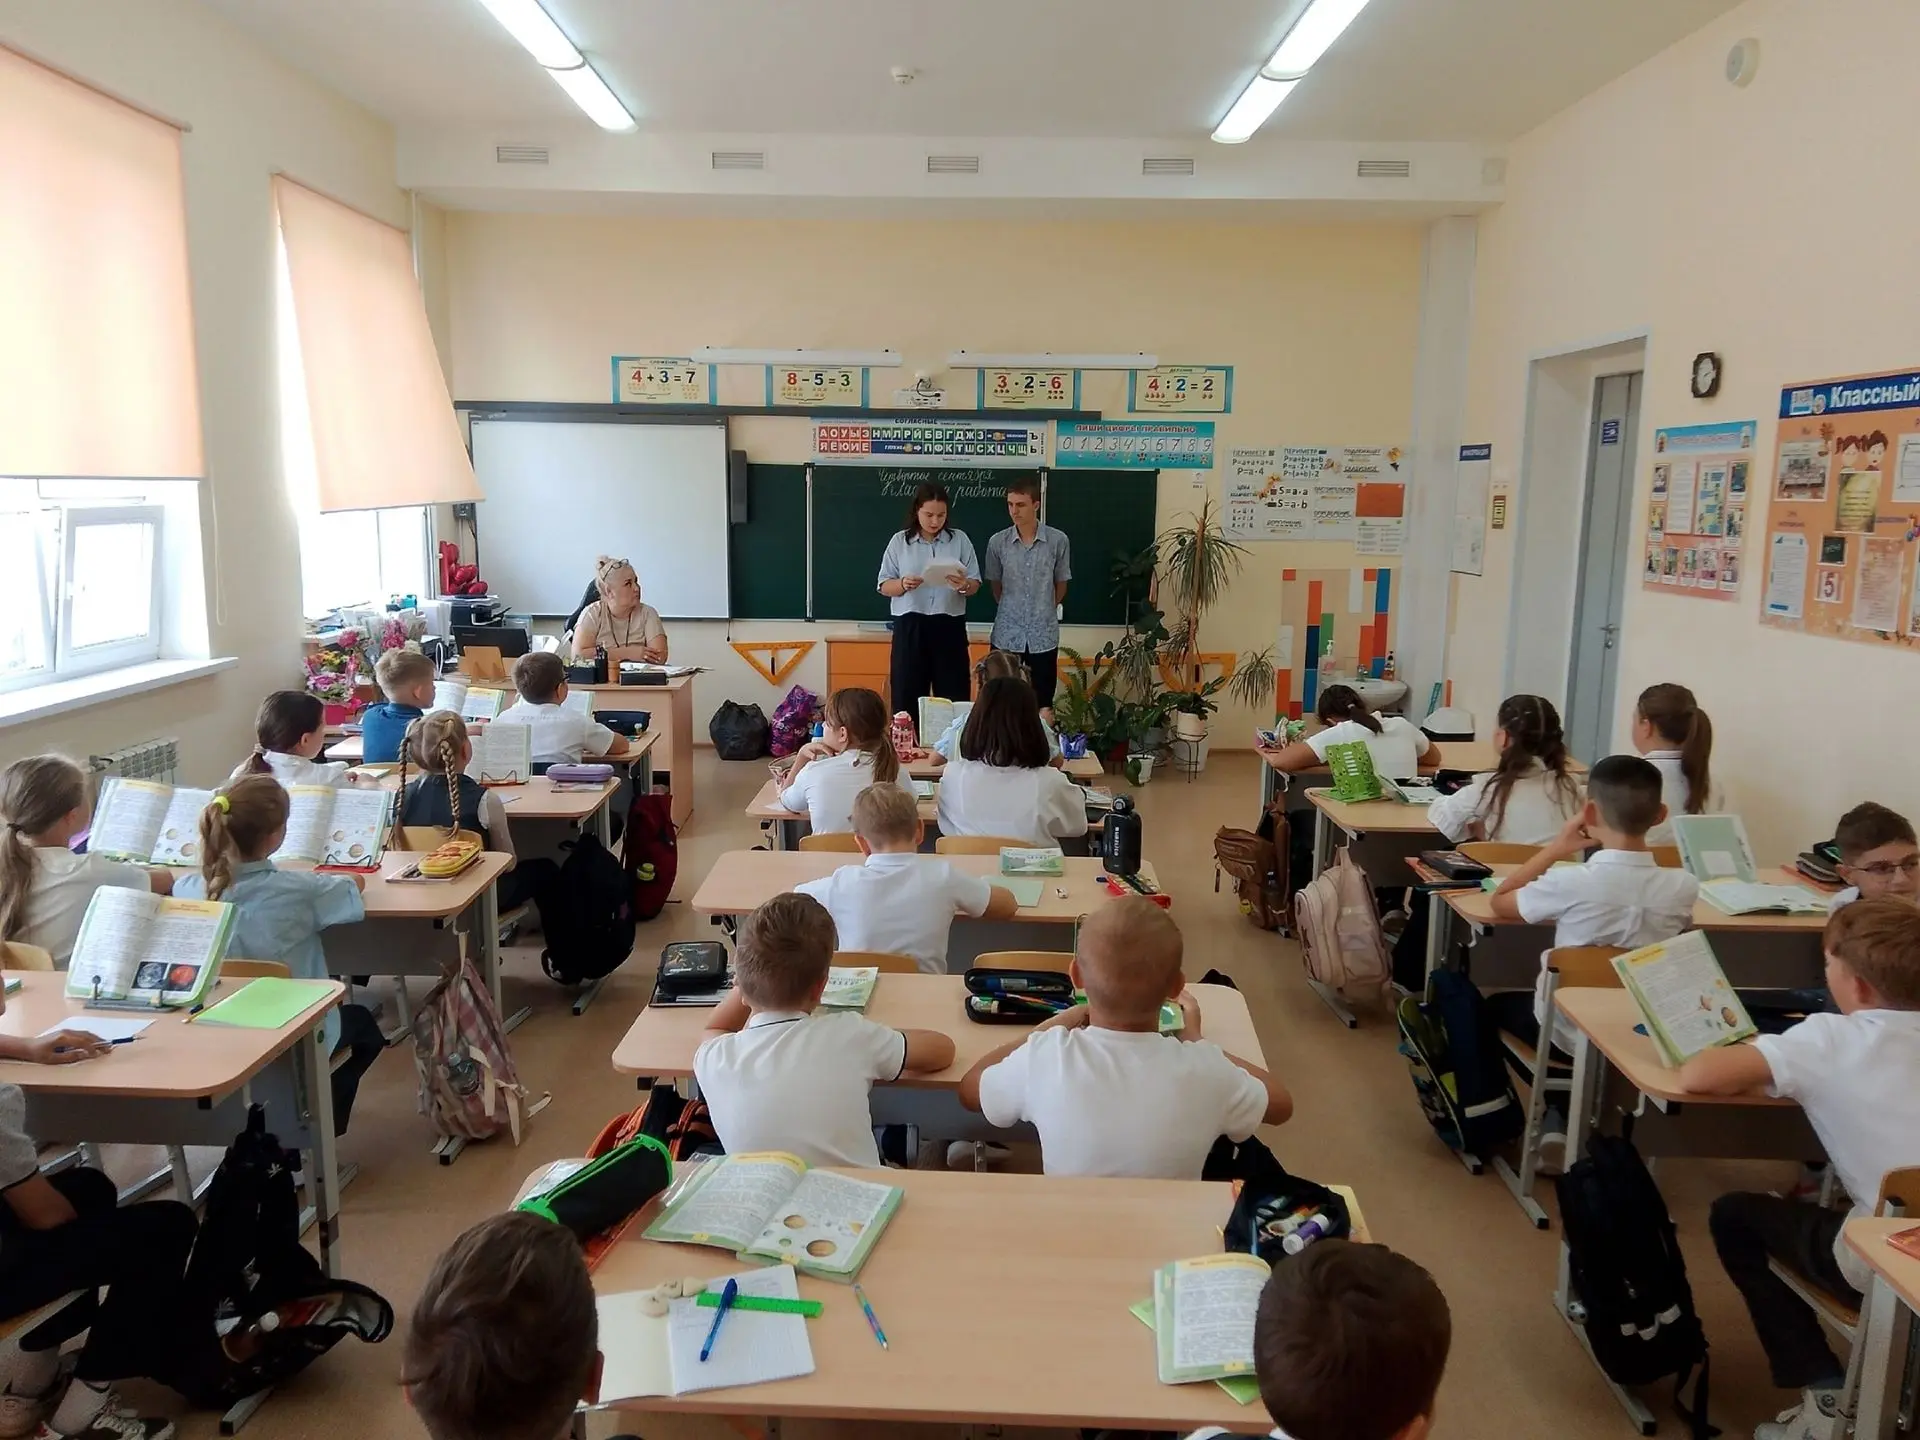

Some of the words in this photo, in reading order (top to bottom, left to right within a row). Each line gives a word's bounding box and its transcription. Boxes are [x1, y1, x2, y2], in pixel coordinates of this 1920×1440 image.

[632, 370, 642, 382] 4
[647, 373, 654, 381] +
[659, 370, 669, 383] 3
[686, 371, 696, 384] 7
[787, 372, 797, 385] 8
[814, 373, 824, 386] 5
[841, 374, 850, 386] 3
[997, 375, 1008, 389] 3
[1024, 375, 1034, 389] 2
[1051, 376, 1061, 390] 6
[1149, 378, 1159, 391] 4
[1176, 378, 1186, 391] 2
[1203, 378, 1213, 391] 2
[1829, 376, 1920, 409] Классный
[1075, 424, 1104, 432] ПИШИ
[1139, 425, 1196, 433] ПРАВИЛЬНО
[1063, 437, 1072, 450] 0
[1080, 437, 1087, 449] 1
[1095, 437, 1104, 450] 2
[1109, 438, 1119, 450] 3
[1124, 438, 1134, 450] 4
[1140, 438, 1149, 450] 5
[1156, 438, 1165, 451] 6
[1172, 438, 1180, 450] 7
[1187, 438, 1196, 451] 8
[1202, 438, 1212, 451] 9
